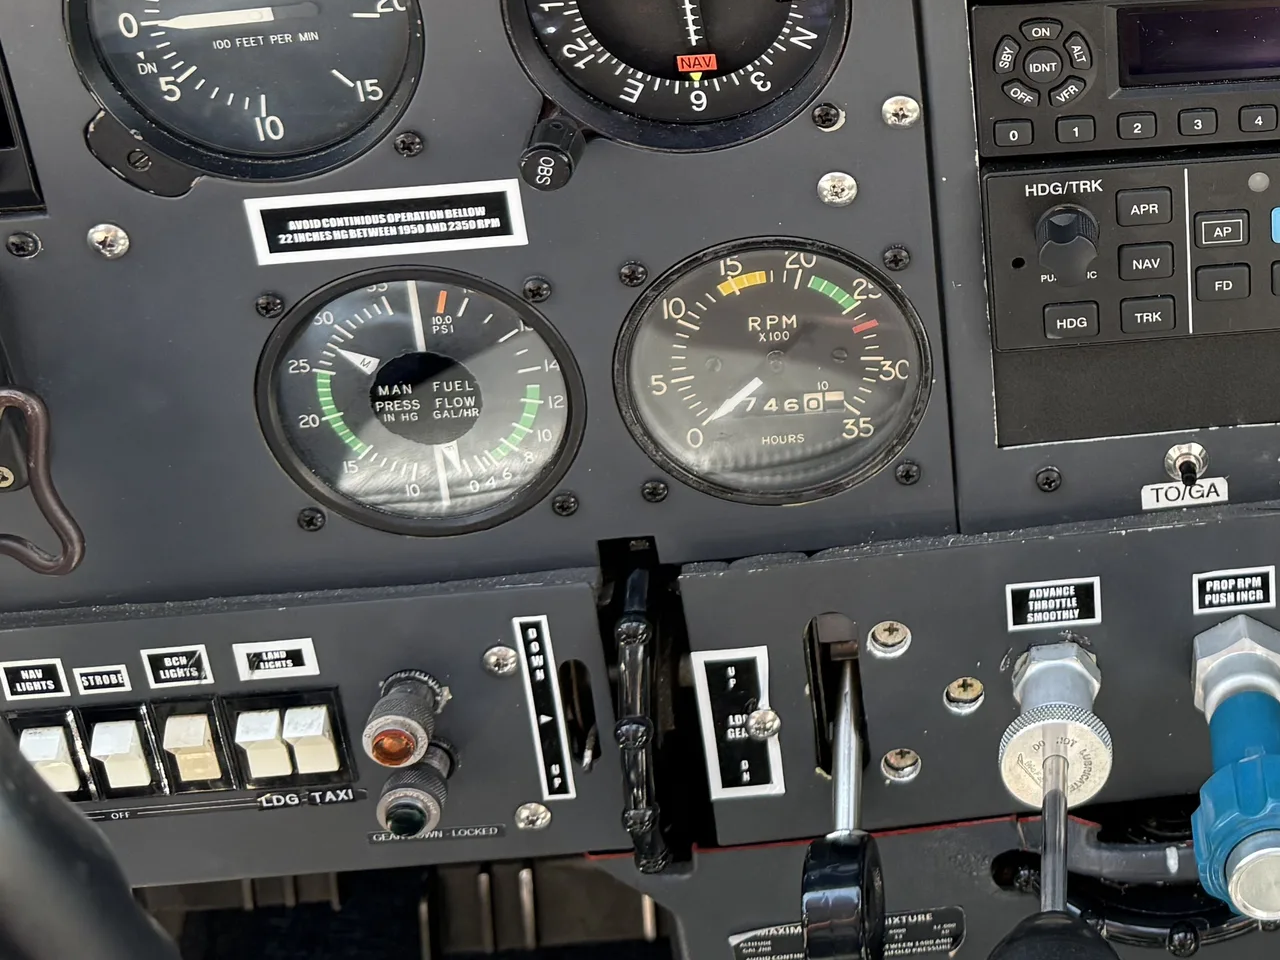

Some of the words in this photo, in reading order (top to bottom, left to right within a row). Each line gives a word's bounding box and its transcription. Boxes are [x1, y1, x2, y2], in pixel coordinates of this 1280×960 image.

[1032, 27, 1050, 37] ON
[213, 39, 231, 50] 100
[236, 36, 264, 47] FEET
[270, 34, 293, 44] PER
[299, 31, 319, 42] MIN
[680, 56, 713, 69] NAV
[1029, 62, 1057, 73] IDNT
[1025, 179, 1103, 197] HDG/TRK
[1130, 204, 1158, 216] APR
[288, 219, 321, 231] AVOID
[387, 210, 443, 224] OPERATION
[445, 206, 486, 218] BELLOW
[278, 234, 292, 244] 22
[293, 231, 332, 242] INCHES
[333, 230, 349, 239] HG
[350, 227, 397, 238] BETWEEN
[398, 224, 425, 235] 1950
[426, 223, 447, 232] AND
[448, 220, 476, 232] 2350
[477, 218, 500, 228] RPM
[1214, 226, 1232, 237] AP
[1132, 258, 1160, 270] NAV
[748, 315, 797, 330] RPM
[1056, 318, 1088, 329] HDG
[1135, 311, 1162, 324] TRK
[433, 325, 454, 334] PSI
[379, 384, 412, 395] MAN
[433, 381, 474, 391] FUEL
[376, 400, 420, 411] PRESS
[436, 397, 475, 407] FLOW
[433, 408, 479, 418] GAL/HR
[842, 417, 874, 438] 35
[762, 434, 805, 445] HOURS
[1151, 485, 1221, 501] TO/GA
[1206, 578, 1236, 591] PROP
[1238, 576, 1262, 589] RPM
[1029, 586, 1075, 598] ADVANCE
[1205, 591, 1235, 604] PUSH
[1236, 589, 1263, 602] INCR
[1028, 597, 1078, 610] THROTTLE
[1026, 609, 1080, 622] SMOOTHLY
[21, 669, 42, 679] NAV
[82, 673, 124, 687] STROBE
[15, 680, 55, 691] LIGHTS
[262, 794, 299, 806] LDG
[314, 789, 353, 802] TAXI
[452, 826, 498, 836] LOCKED
